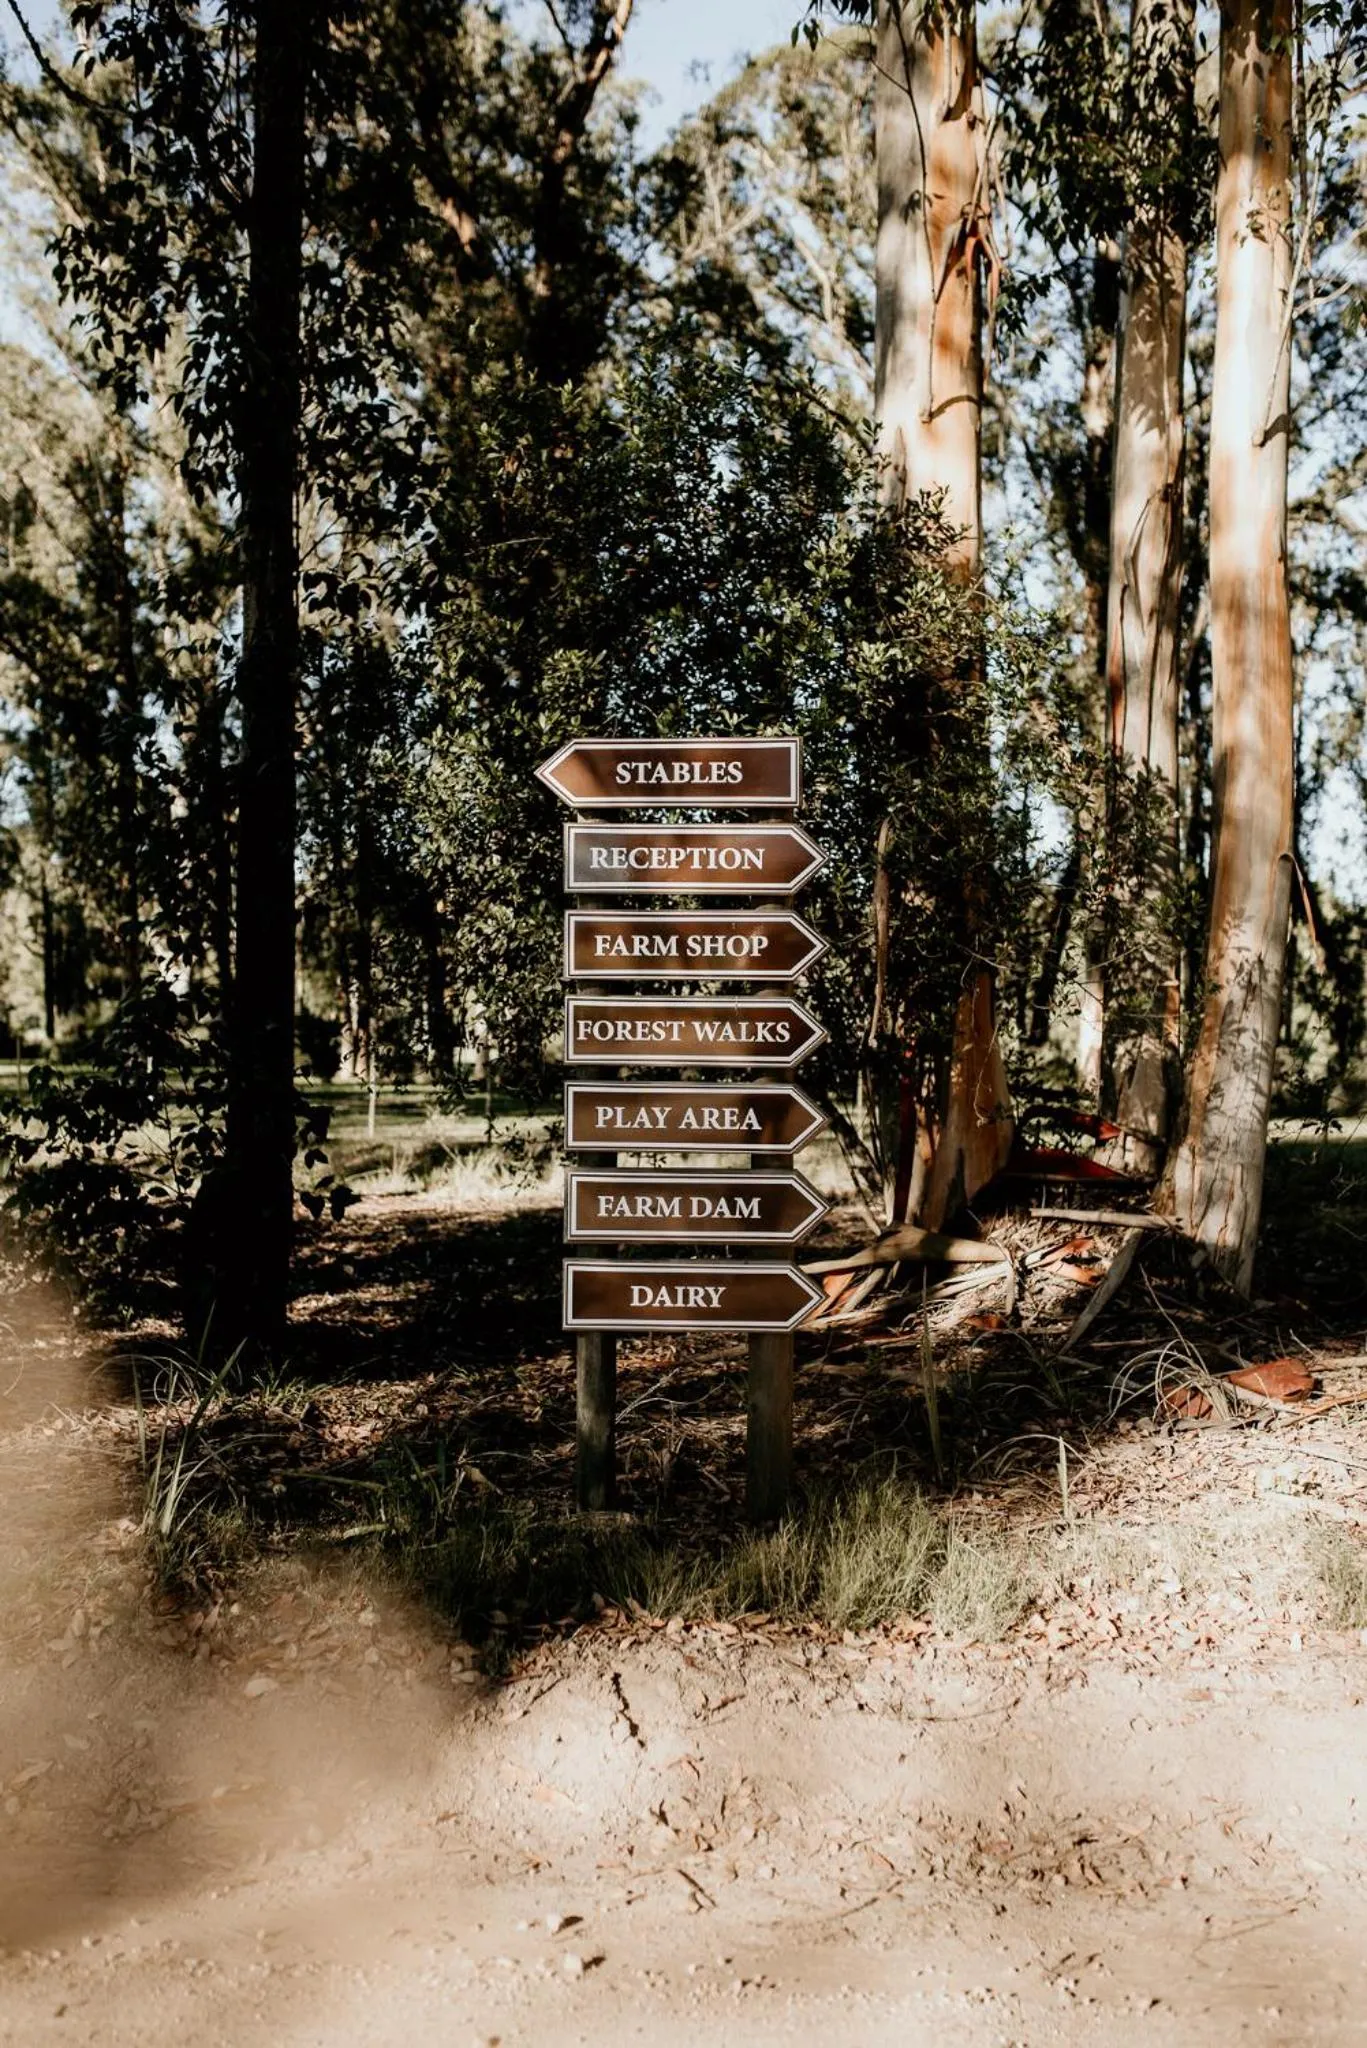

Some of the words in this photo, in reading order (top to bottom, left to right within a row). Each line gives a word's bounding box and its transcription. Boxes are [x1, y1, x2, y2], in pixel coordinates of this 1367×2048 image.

[616, 761, 743, 784] STABLES
[590, 847, 765, 870] RECEPTION
[594, 935, 679, 957] FARM
[686, 935, 769, 957] SHOP
[577, 1021, 685, 1043] FOREST
[691, 1021, 790, 1043] WALKS
[595, 1106, 672, 1129] PLAY
[679, 1107, 762, 1131] AREA
[597, 1195, 683, 1218] FARM
[689, 1197, 761, 1219] DAM
[630, 1285, 726, 1308] DAIRY
